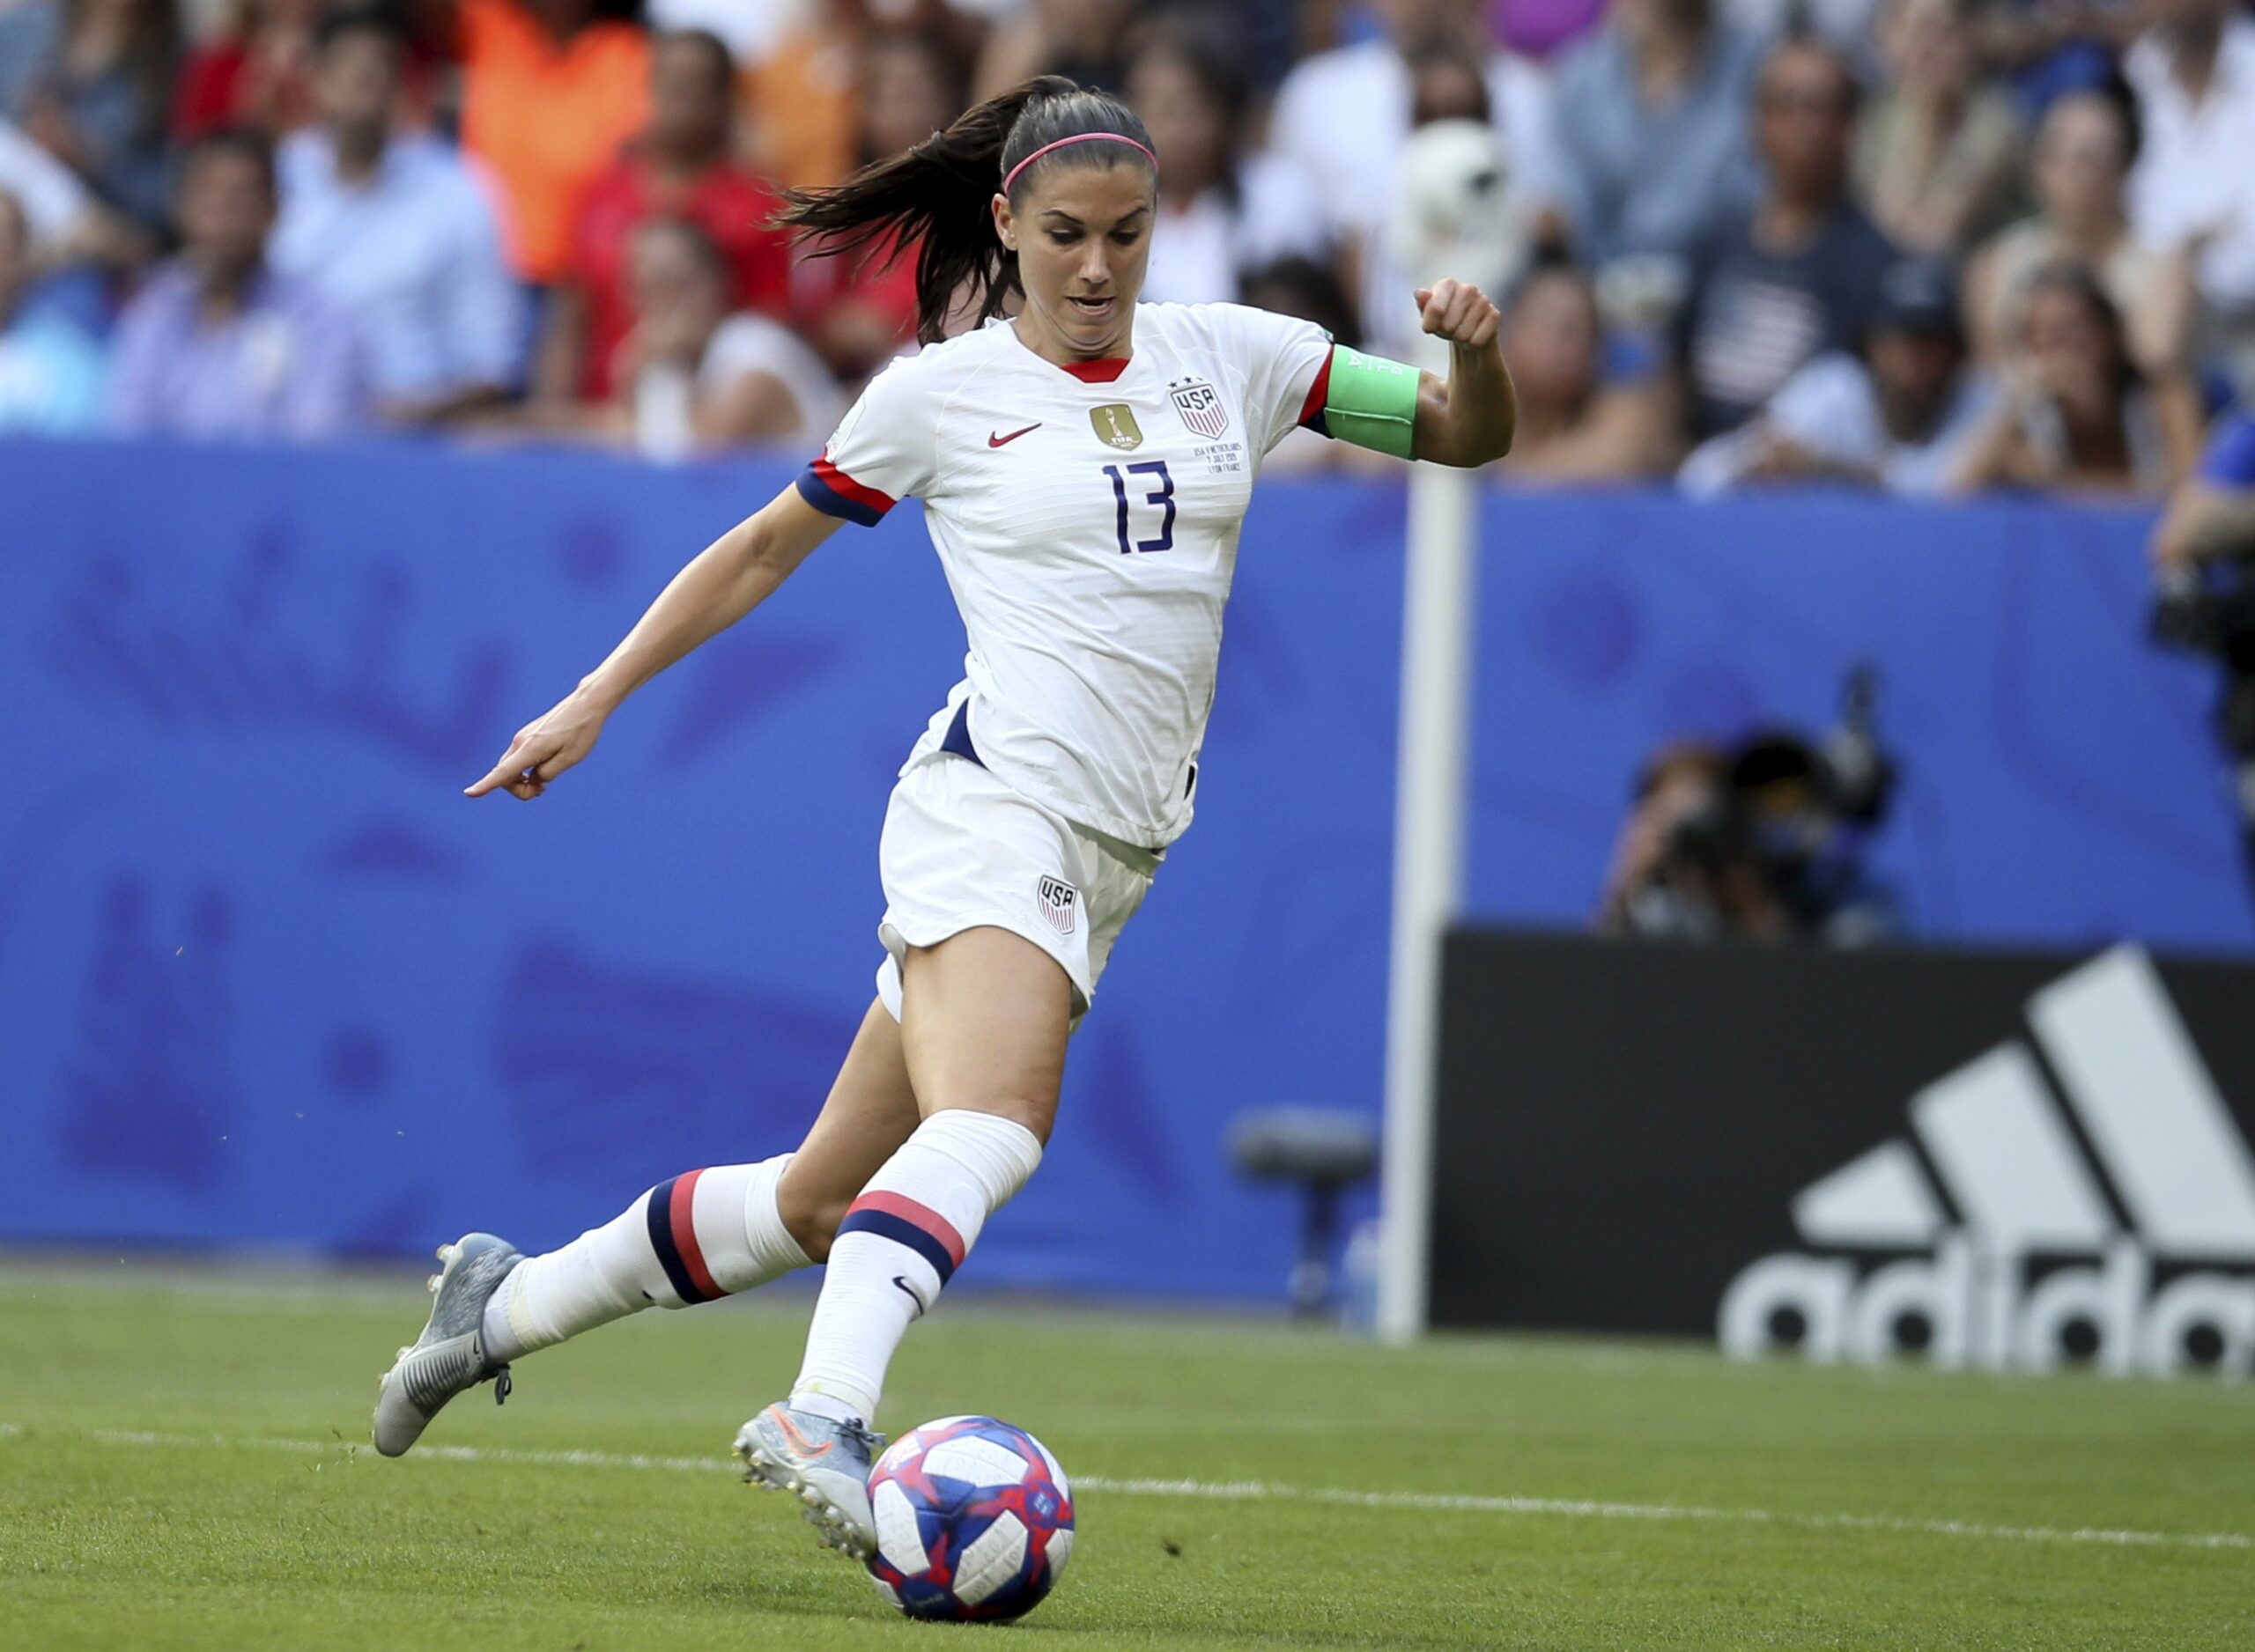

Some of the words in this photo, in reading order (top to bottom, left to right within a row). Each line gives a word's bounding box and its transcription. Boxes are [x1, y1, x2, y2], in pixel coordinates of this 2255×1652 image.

[1176, 388, 1214, 410] USA
[1194, 446, 1206, 456] USA
[1102, 460, 1176, 554] 13
[1041, 881, 1074, 907] USA
